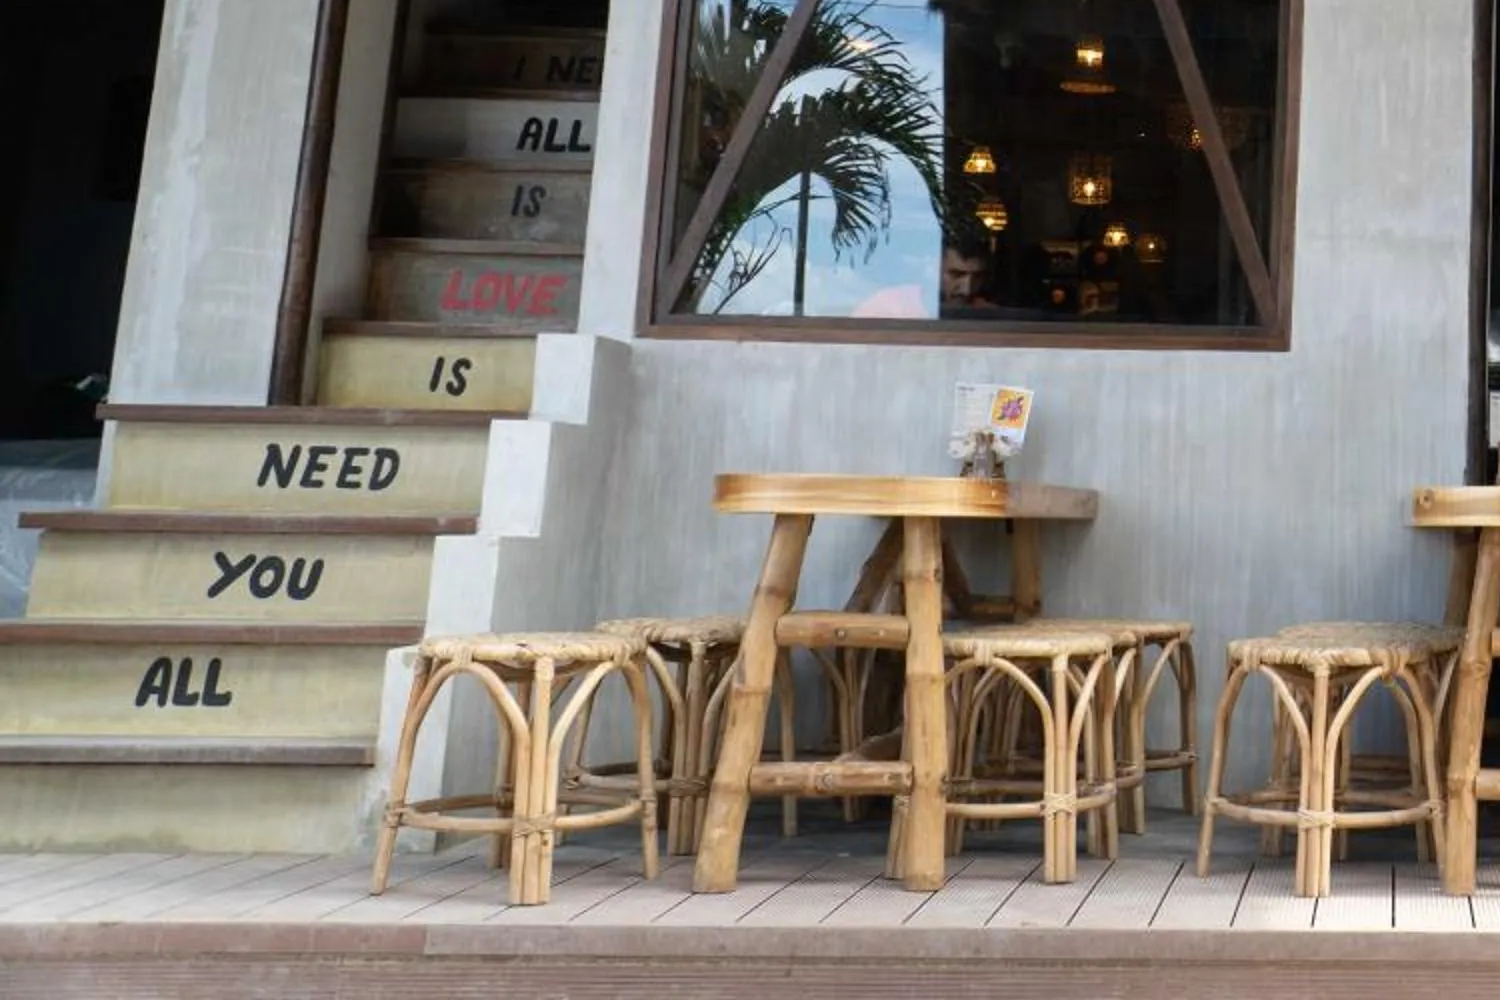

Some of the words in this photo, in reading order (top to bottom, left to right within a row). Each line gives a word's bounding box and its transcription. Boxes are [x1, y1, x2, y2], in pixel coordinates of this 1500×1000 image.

[546, 55, 603, 85] NE
[516, 117, 591, 152] ALL
[511, 185, 546, 218] IS
[440, 267, 570, 315] LOVE
[429, 356, 472, 396] IS
[257, 443, 399, 490] NEED
[207, 551, 324, 600] YOU
[135, 657, 232, 708] ALL
